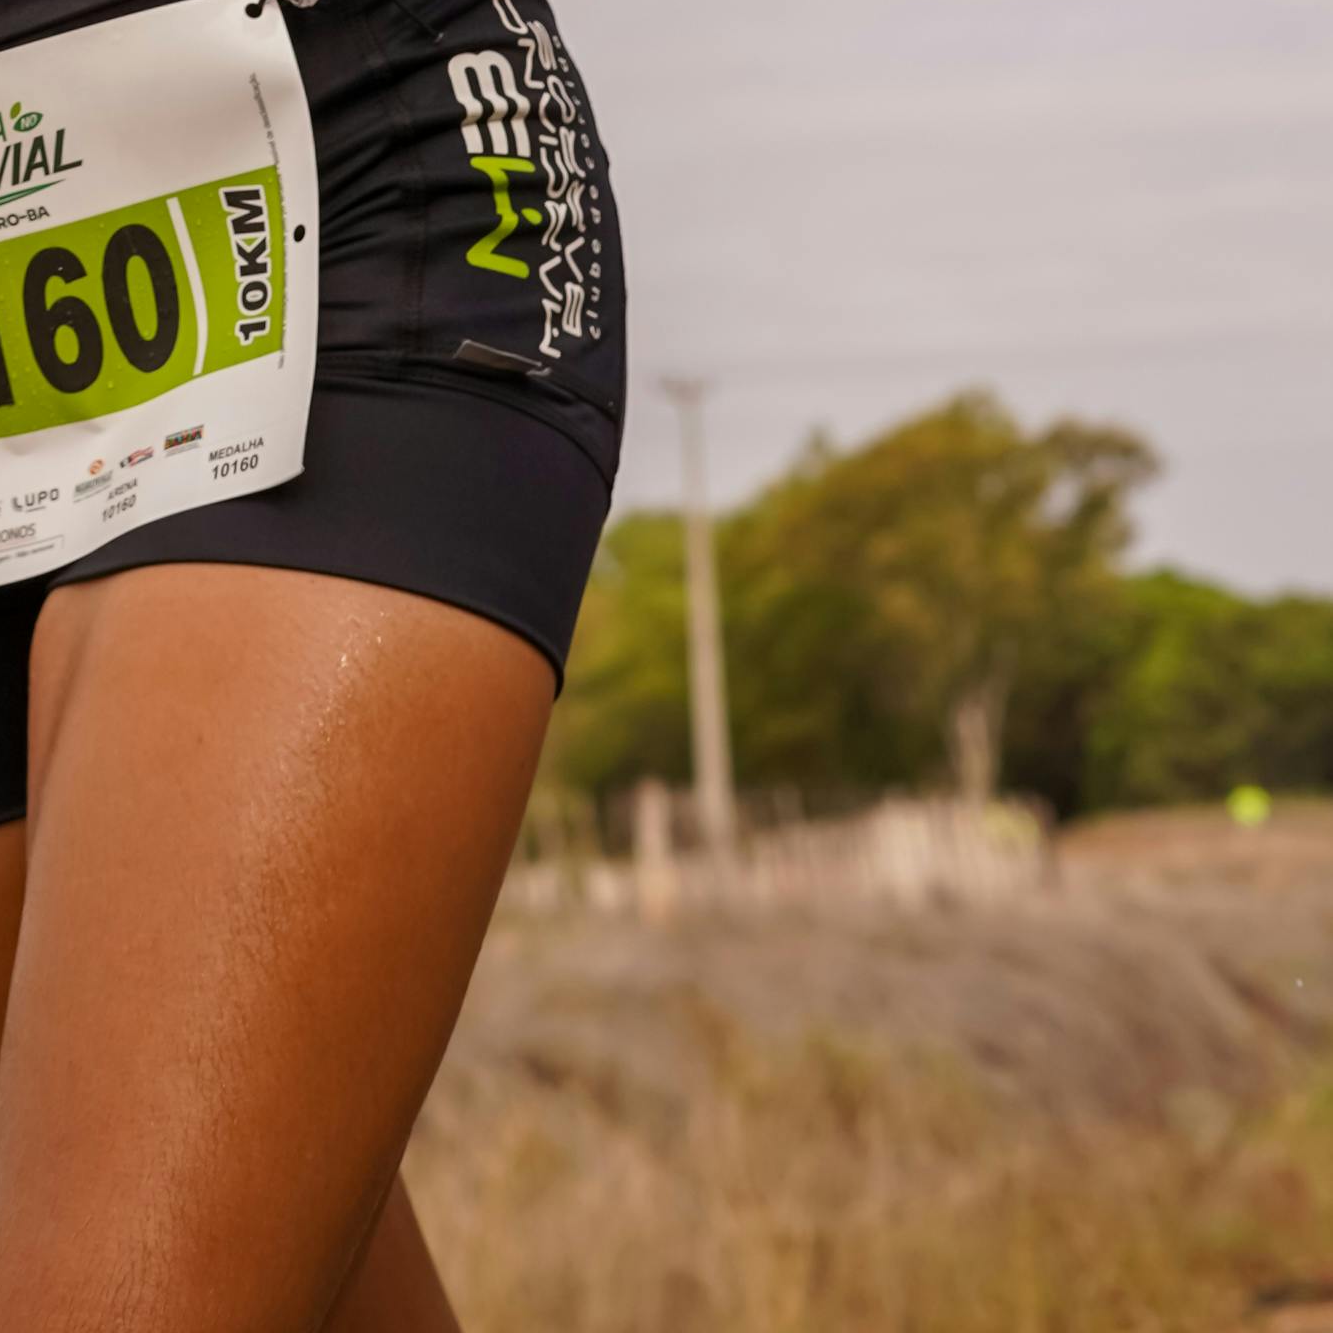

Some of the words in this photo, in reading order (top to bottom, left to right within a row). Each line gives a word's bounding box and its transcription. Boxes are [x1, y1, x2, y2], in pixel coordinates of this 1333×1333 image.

[221, 186, 270, 344] 10KM
[209, 437, 264, 462] MEDALHA
[212, 454, 259, 480] 10160
[12, 488, 59, 511] LUPO
[108, 477, 138, 500] ARENA
[101, 494, 137, 523] 10160
